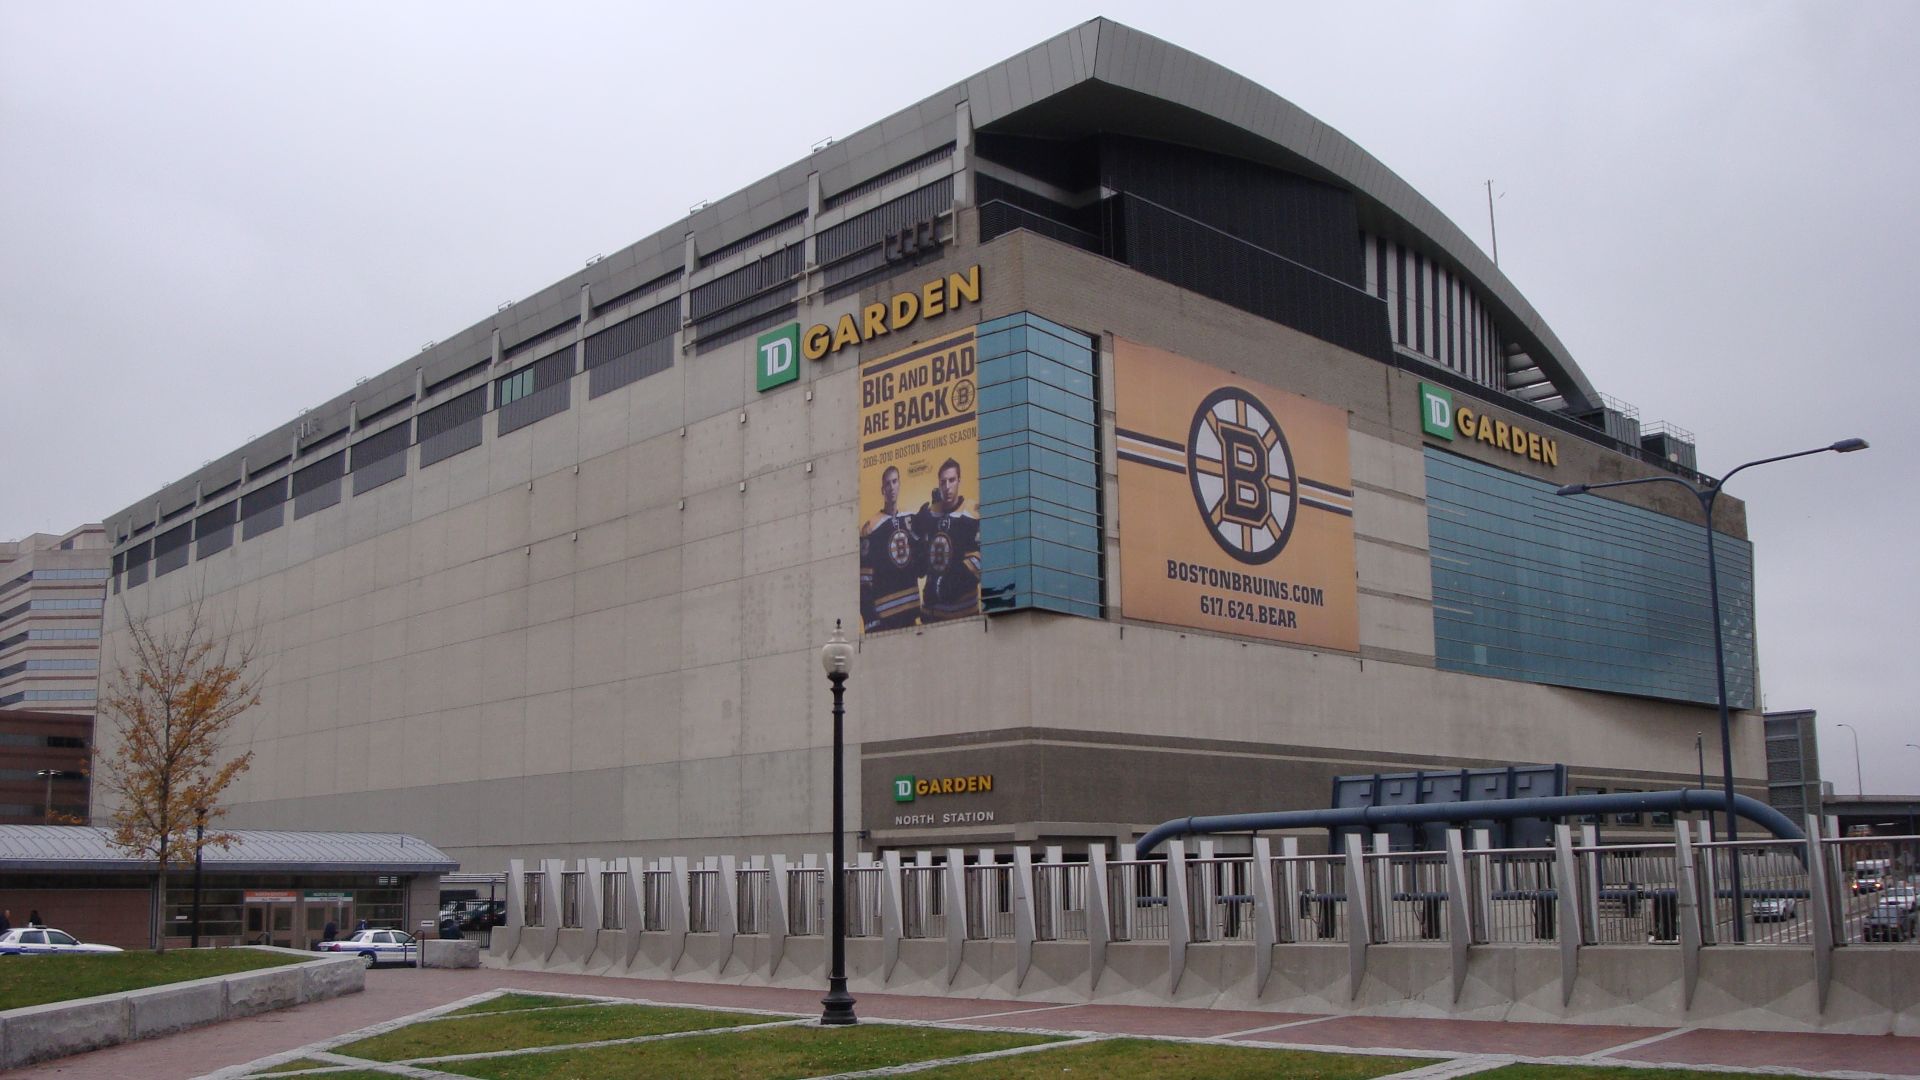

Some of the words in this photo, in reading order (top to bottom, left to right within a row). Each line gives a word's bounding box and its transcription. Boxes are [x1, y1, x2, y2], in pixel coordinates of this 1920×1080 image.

[761, 337, 791, 376] TD
[802, 264, 981, 361] GARDEN
[862, 372, 895, 409] BIG
[899, 365, 928, 393] AND
[931, 345, 975, 387] BAD
[863, 409, 890, 437] ARE
[894, 387, 949, 431] BACK
[1425, 393, 1451, 428] TD
[1456, 407, 1558, 467] GARDEN
[895, 444, 921, 460] BOSTON
[922, 434, 948, 451] BRUINS
[949, 426, 977, 445] SEASON
[1217, 421, 1270, 529] B
[1167, 559, 1324, 607] BOSTONBRUINS.COM
[1200, 595, 1297, 629] 617.624.BEAR
[895, 780, 912, 796] TD
[916, 774, 993, 796] GARDEN
[895, 814, 935, 826] NORTH
[942, 811, 994, 823] STATION
